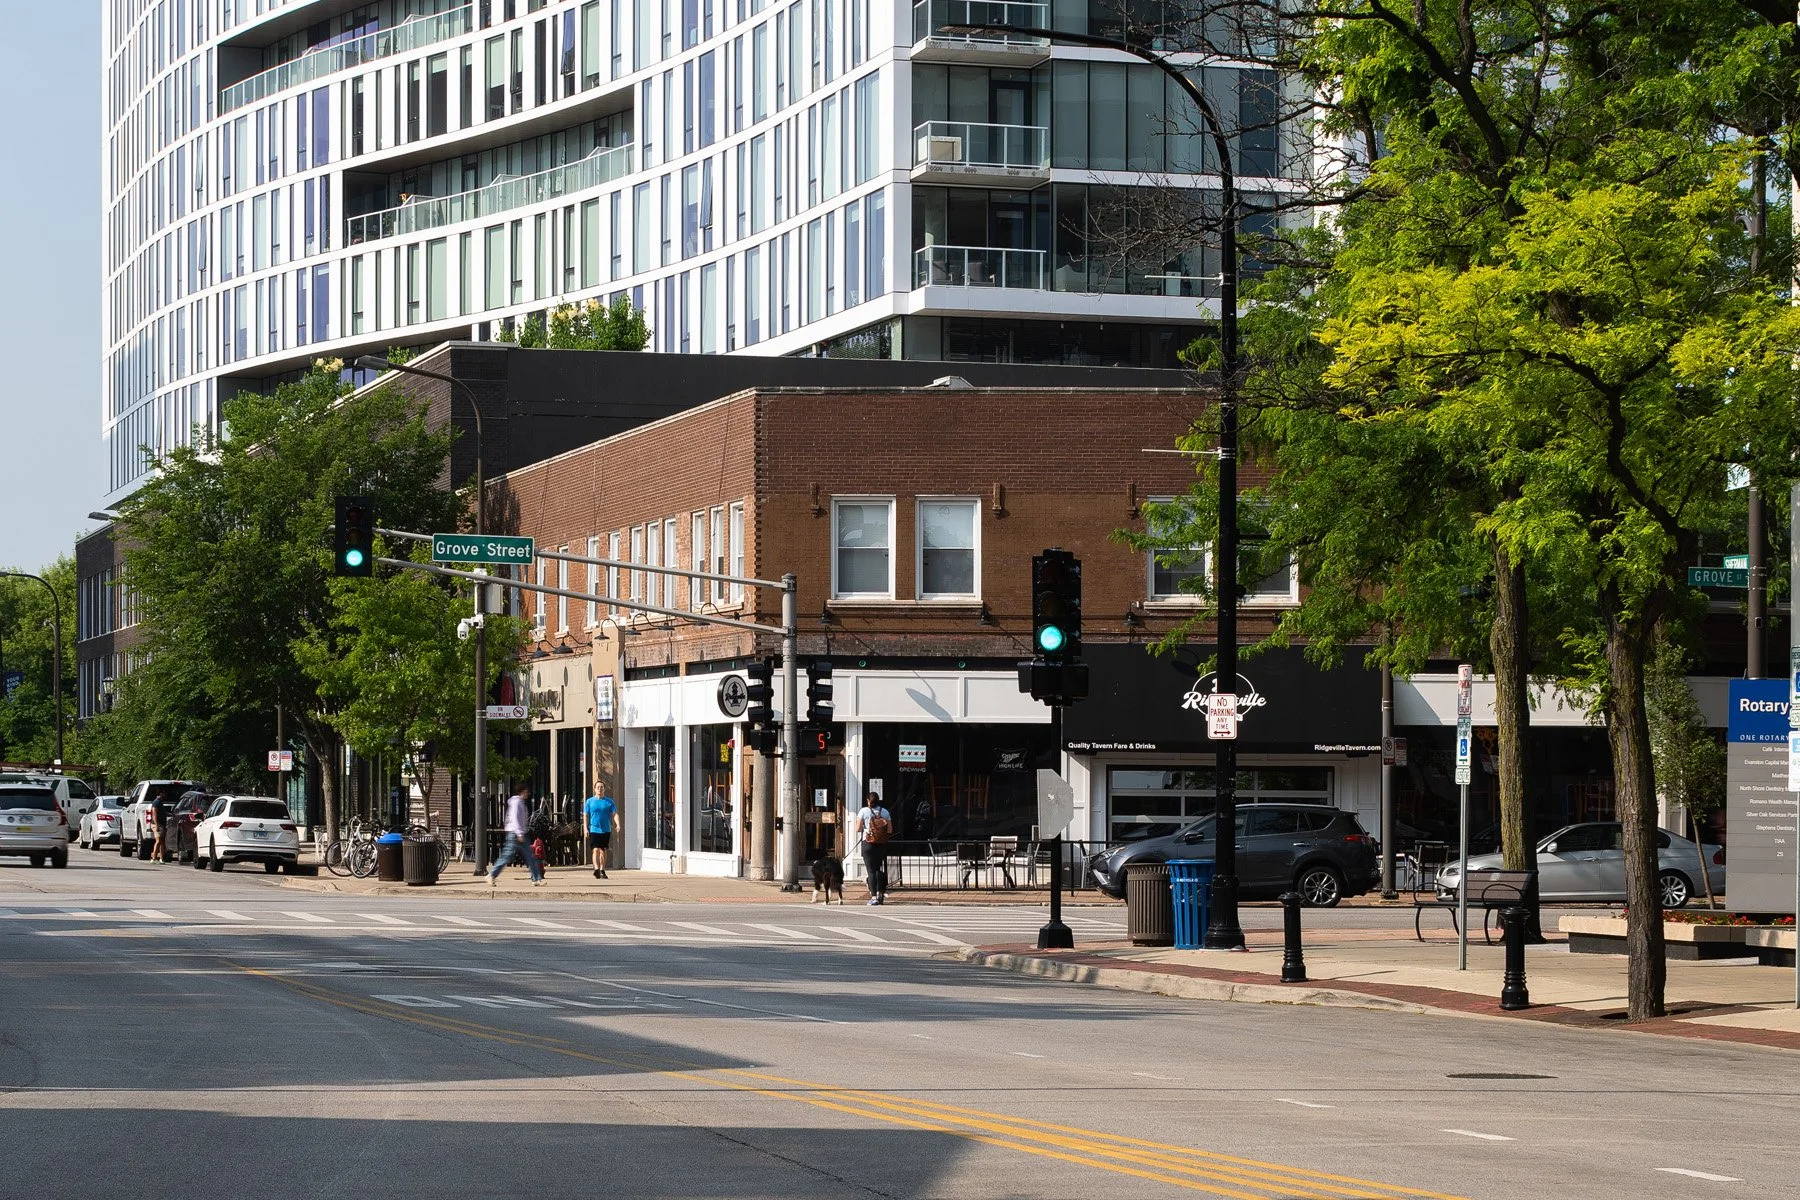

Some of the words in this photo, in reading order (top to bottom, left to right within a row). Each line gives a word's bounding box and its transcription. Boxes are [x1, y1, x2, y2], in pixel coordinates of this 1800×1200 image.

[436, 541, 479, 556] Grove
[487, 542, 530, 558] Street
[1694, 570, 1733, 583] GROVE
[1216, 698, 1228, 707] NO
[1740, 698, 1789, 715] Rotary
[1210, 708, 1235, 717] PARKING
[818, 733, 826, 749] 5
[1068, 742, 1091, 750] Quality
[1314, 744, 1382, 752] RidgevilleTavern.com
